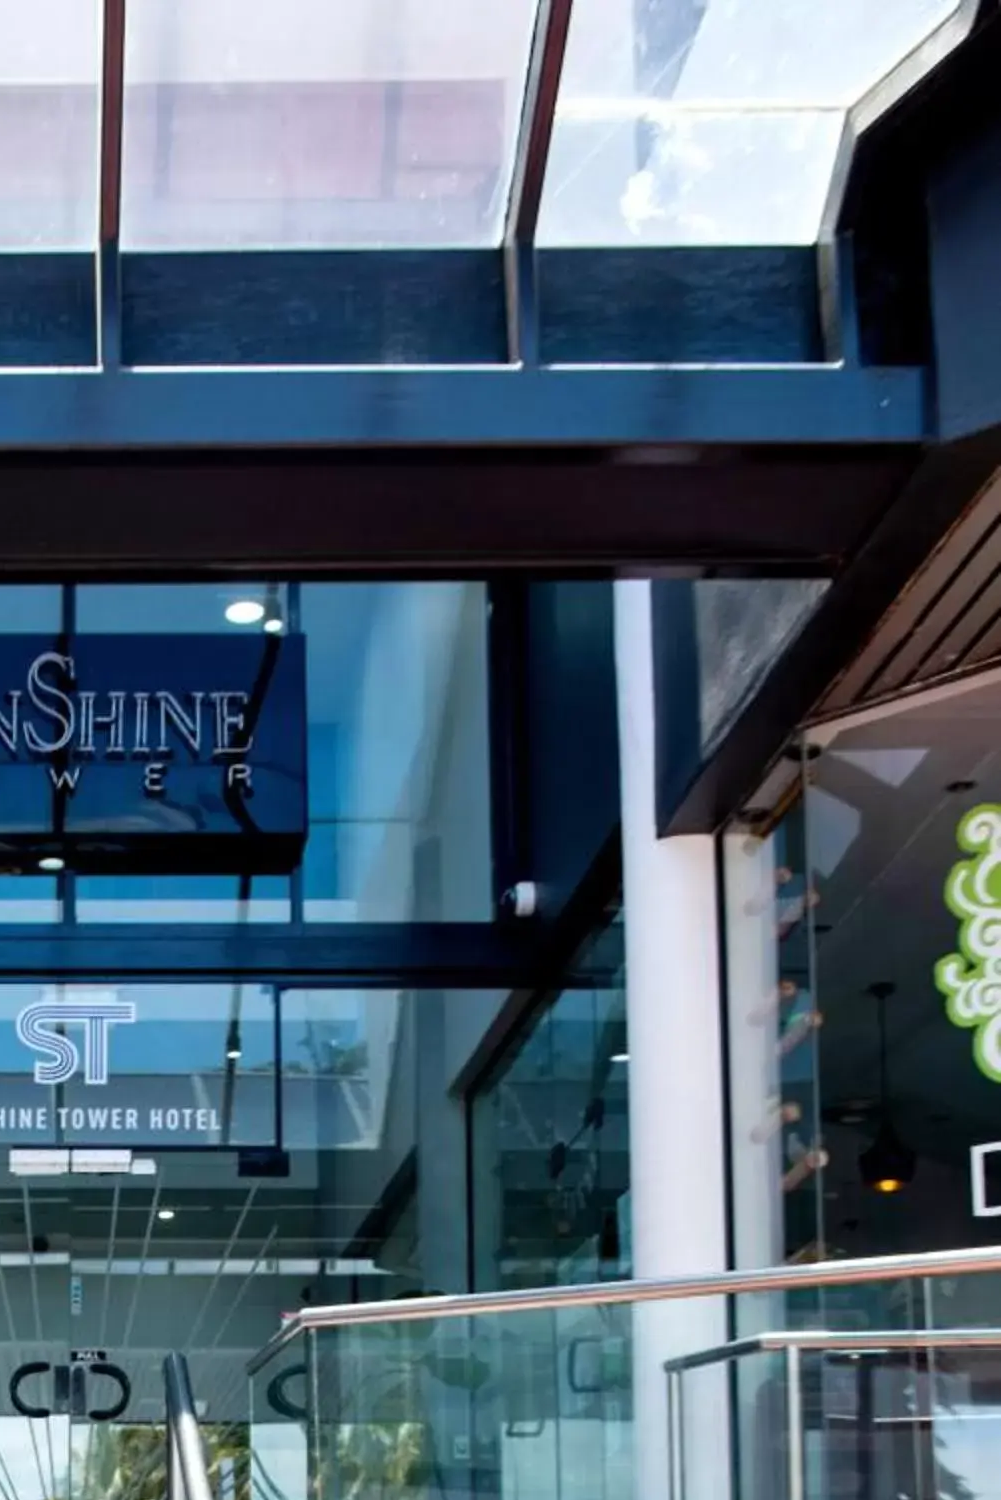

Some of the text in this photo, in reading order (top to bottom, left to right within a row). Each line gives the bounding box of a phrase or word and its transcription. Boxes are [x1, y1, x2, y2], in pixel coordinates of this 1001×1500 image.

[16, 1003, 136, 1085] ST
[57, 1106, 139, 1130] TOWER
[150, 1106, 221, 1130] HOTEL
